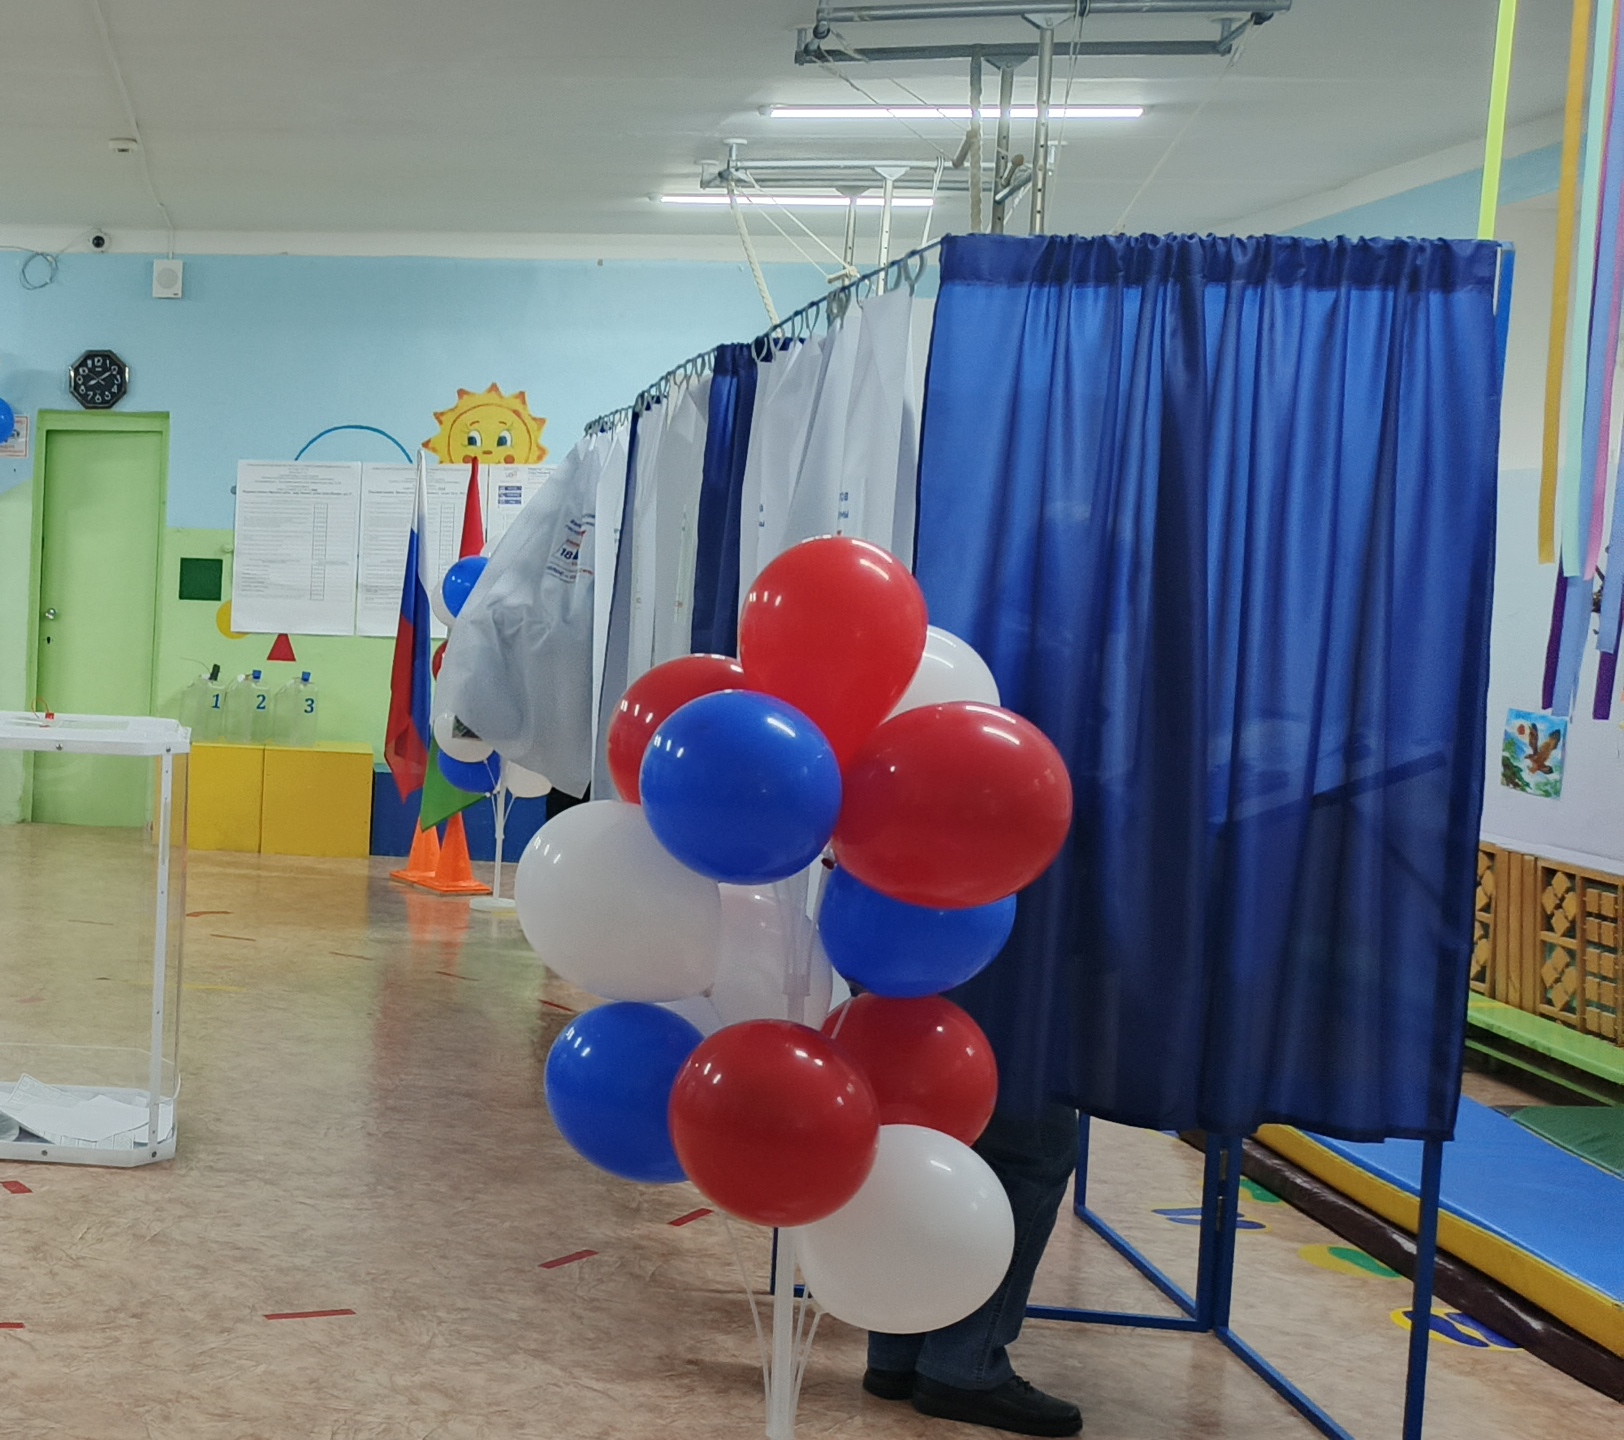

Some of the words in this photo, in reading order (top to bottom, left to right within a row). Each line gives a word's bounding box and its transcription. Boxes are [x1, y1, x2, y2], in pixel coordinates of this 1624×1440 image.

[211, 693, 221, 709] 1
[256, 694, 267, 710] 2
[303, 698, 315, 714] 3
